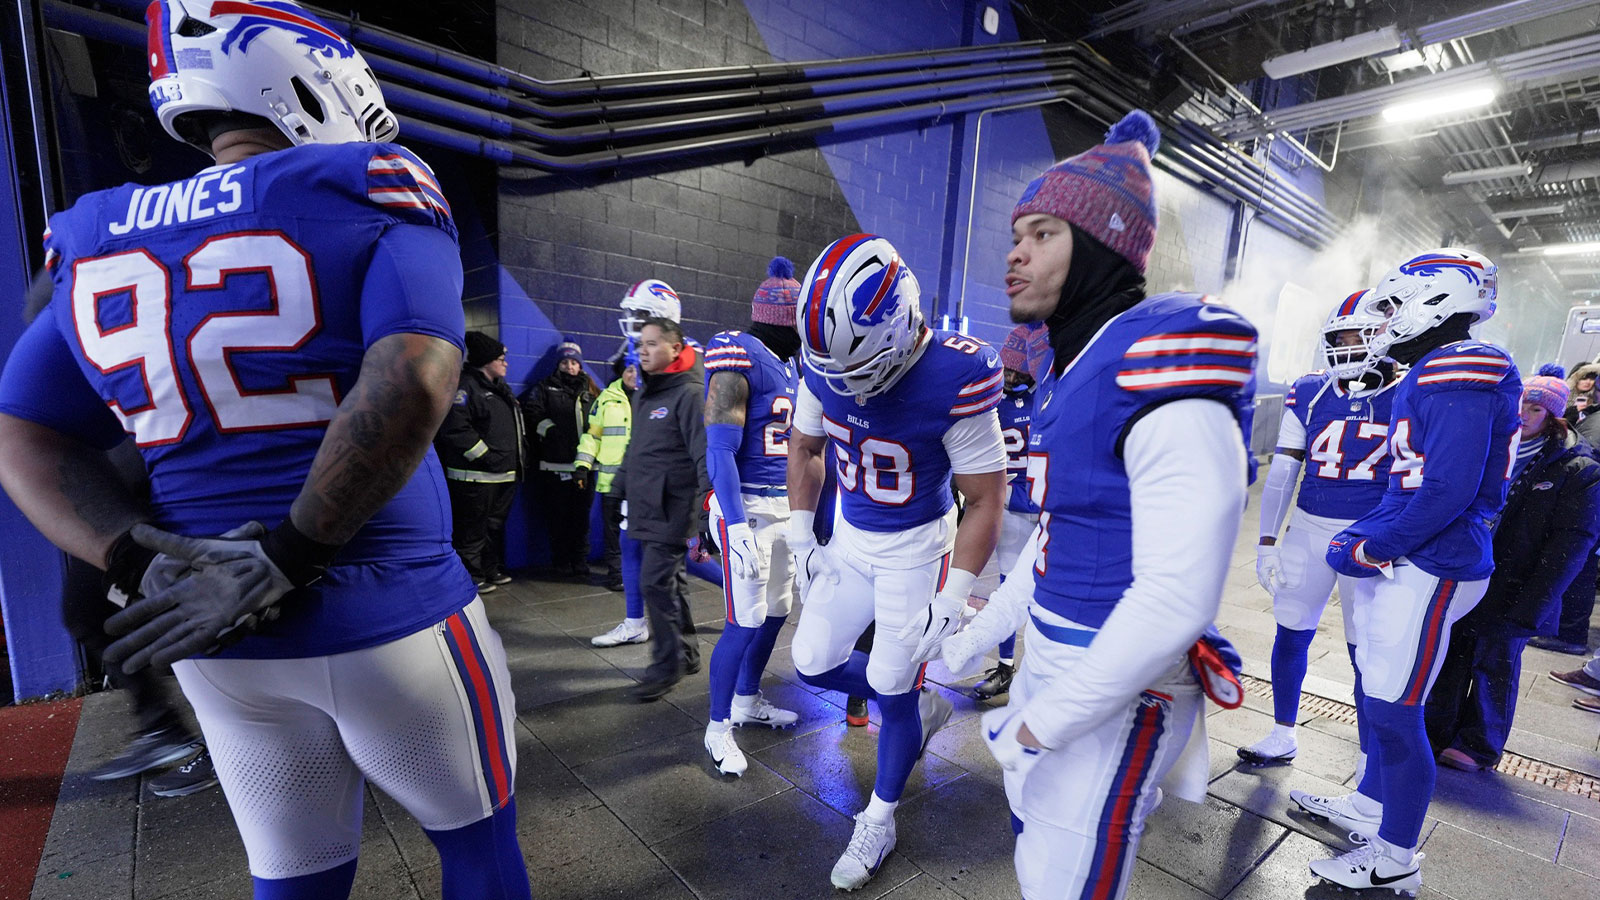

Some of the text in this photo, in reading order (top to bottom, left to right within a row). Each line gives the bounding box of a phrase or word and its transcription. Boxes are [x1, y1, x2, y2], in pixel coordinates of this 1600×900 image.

[109, 165, 247, 236] JONES
[70, 229, 340, 448] 92
[846, 413, 870, 429] BILLS
[1310, 418, 1390, 480] 47
[821, 411, 916, 507] 58
